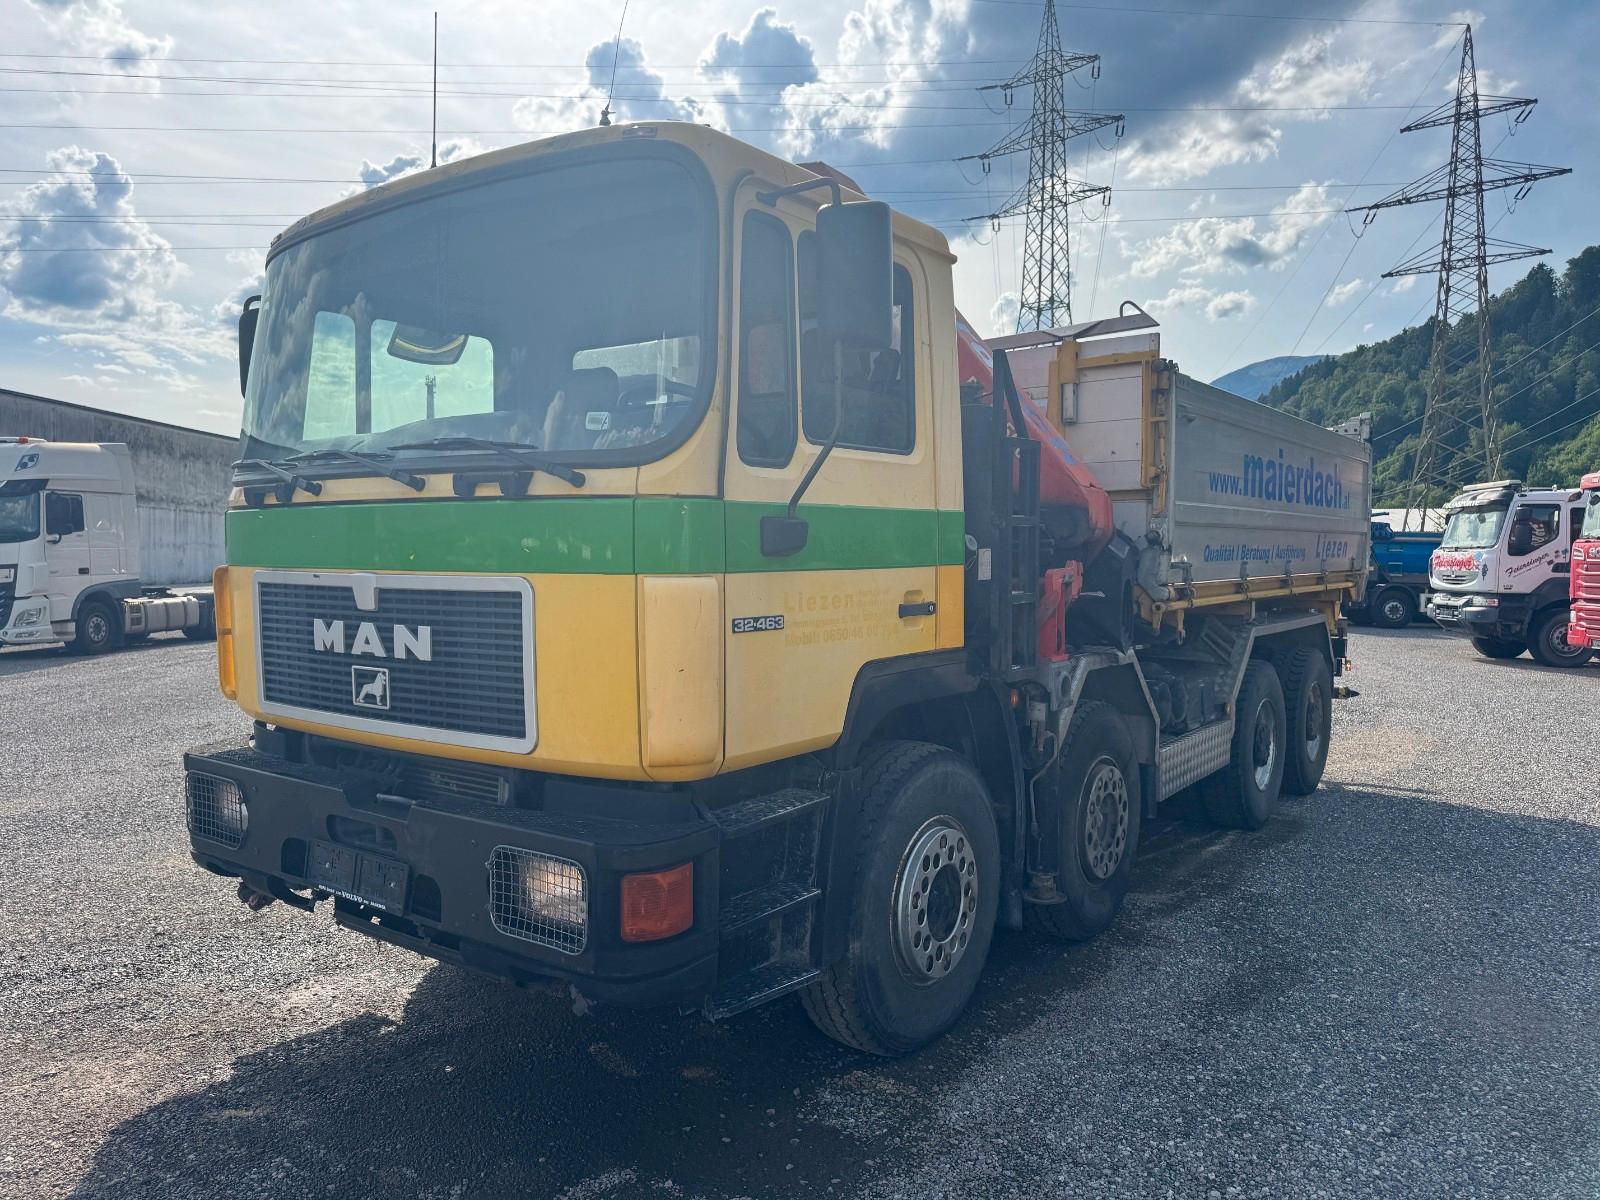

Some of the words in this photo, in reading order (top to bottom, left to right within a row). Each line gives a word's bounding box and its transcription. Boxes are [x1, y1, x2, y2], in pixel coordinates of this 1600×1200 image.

[1203, 545, 1235, 562] Qualität
[1240, 544, 1270, 563] Beratung
[1315, 534, 1349, 559] Liezen
[784, 591, 854, 613] Liezen
[313, 618, 432, 661] MAN
[341, 891, 363, 903] VOLVO
